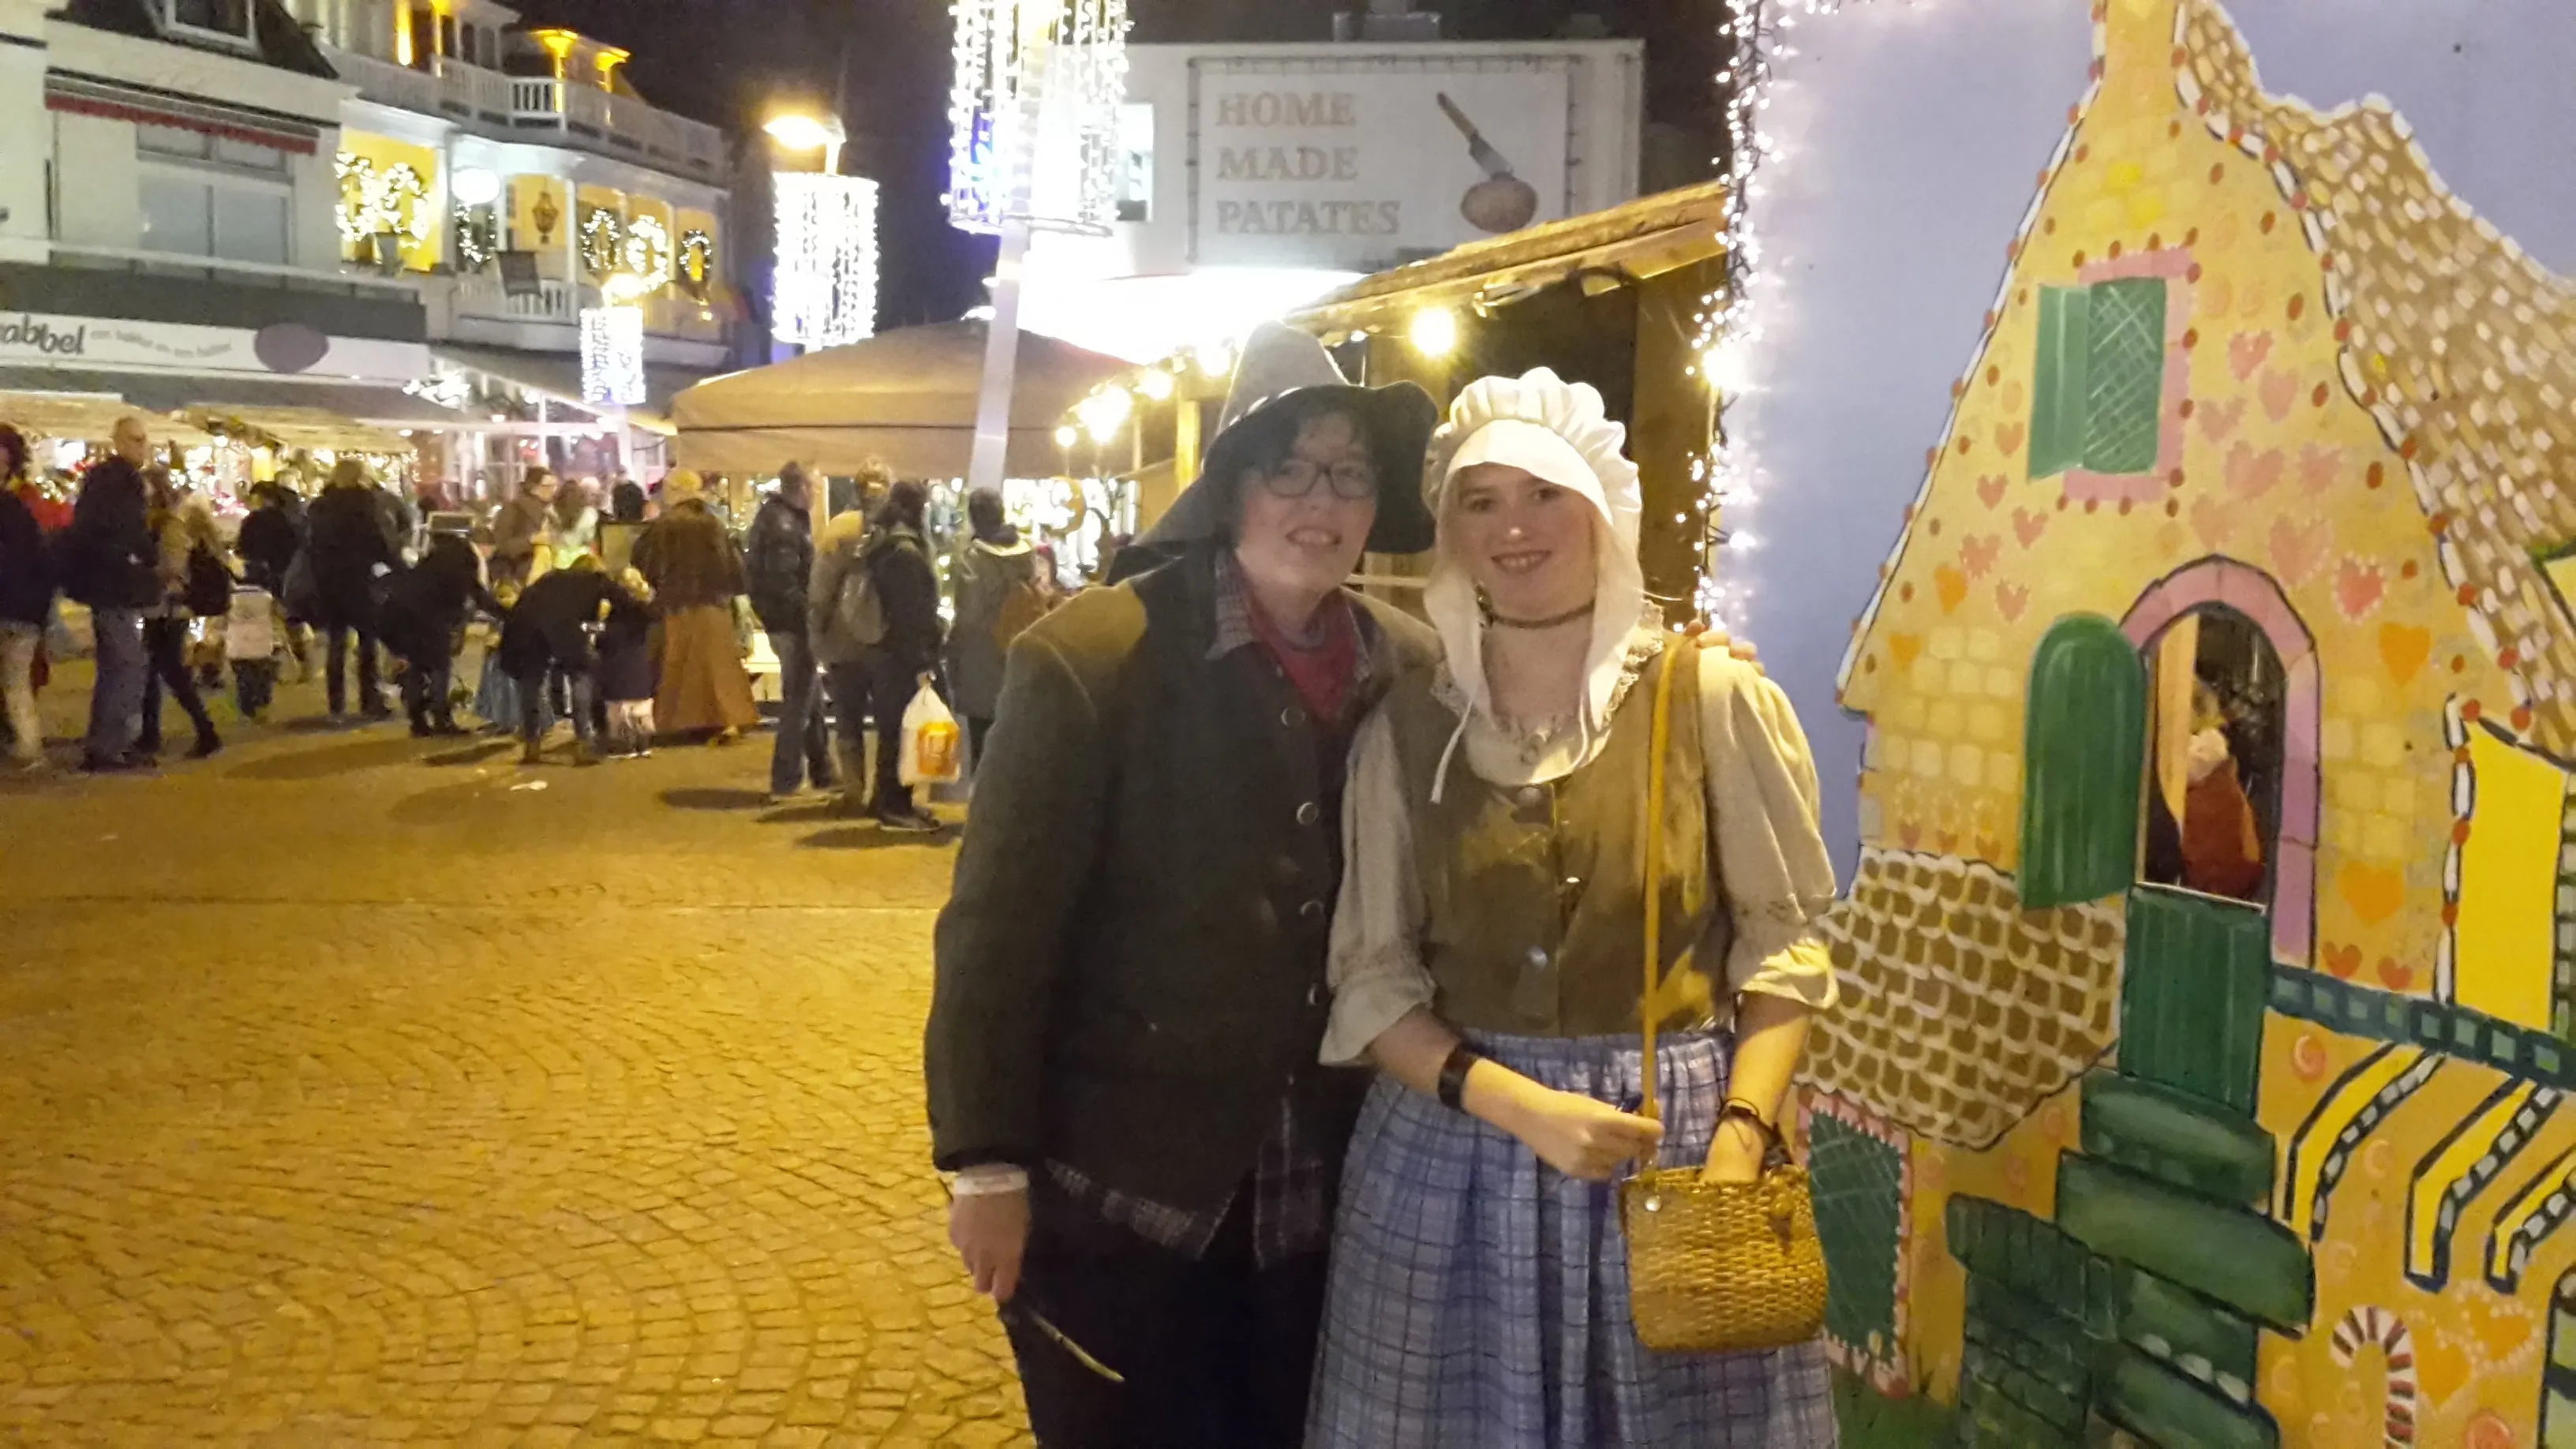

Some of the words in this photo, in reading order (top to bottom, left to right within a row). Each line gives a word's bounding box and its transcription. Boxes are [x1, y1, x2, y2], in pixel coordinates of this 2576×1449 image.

[1215, 92, 1355, 126] HOME
[1215, 146, 1359, 181] MADE
[1216, 200, 1400, 235] PATATES
[0, 313, 84, 354] abbel
